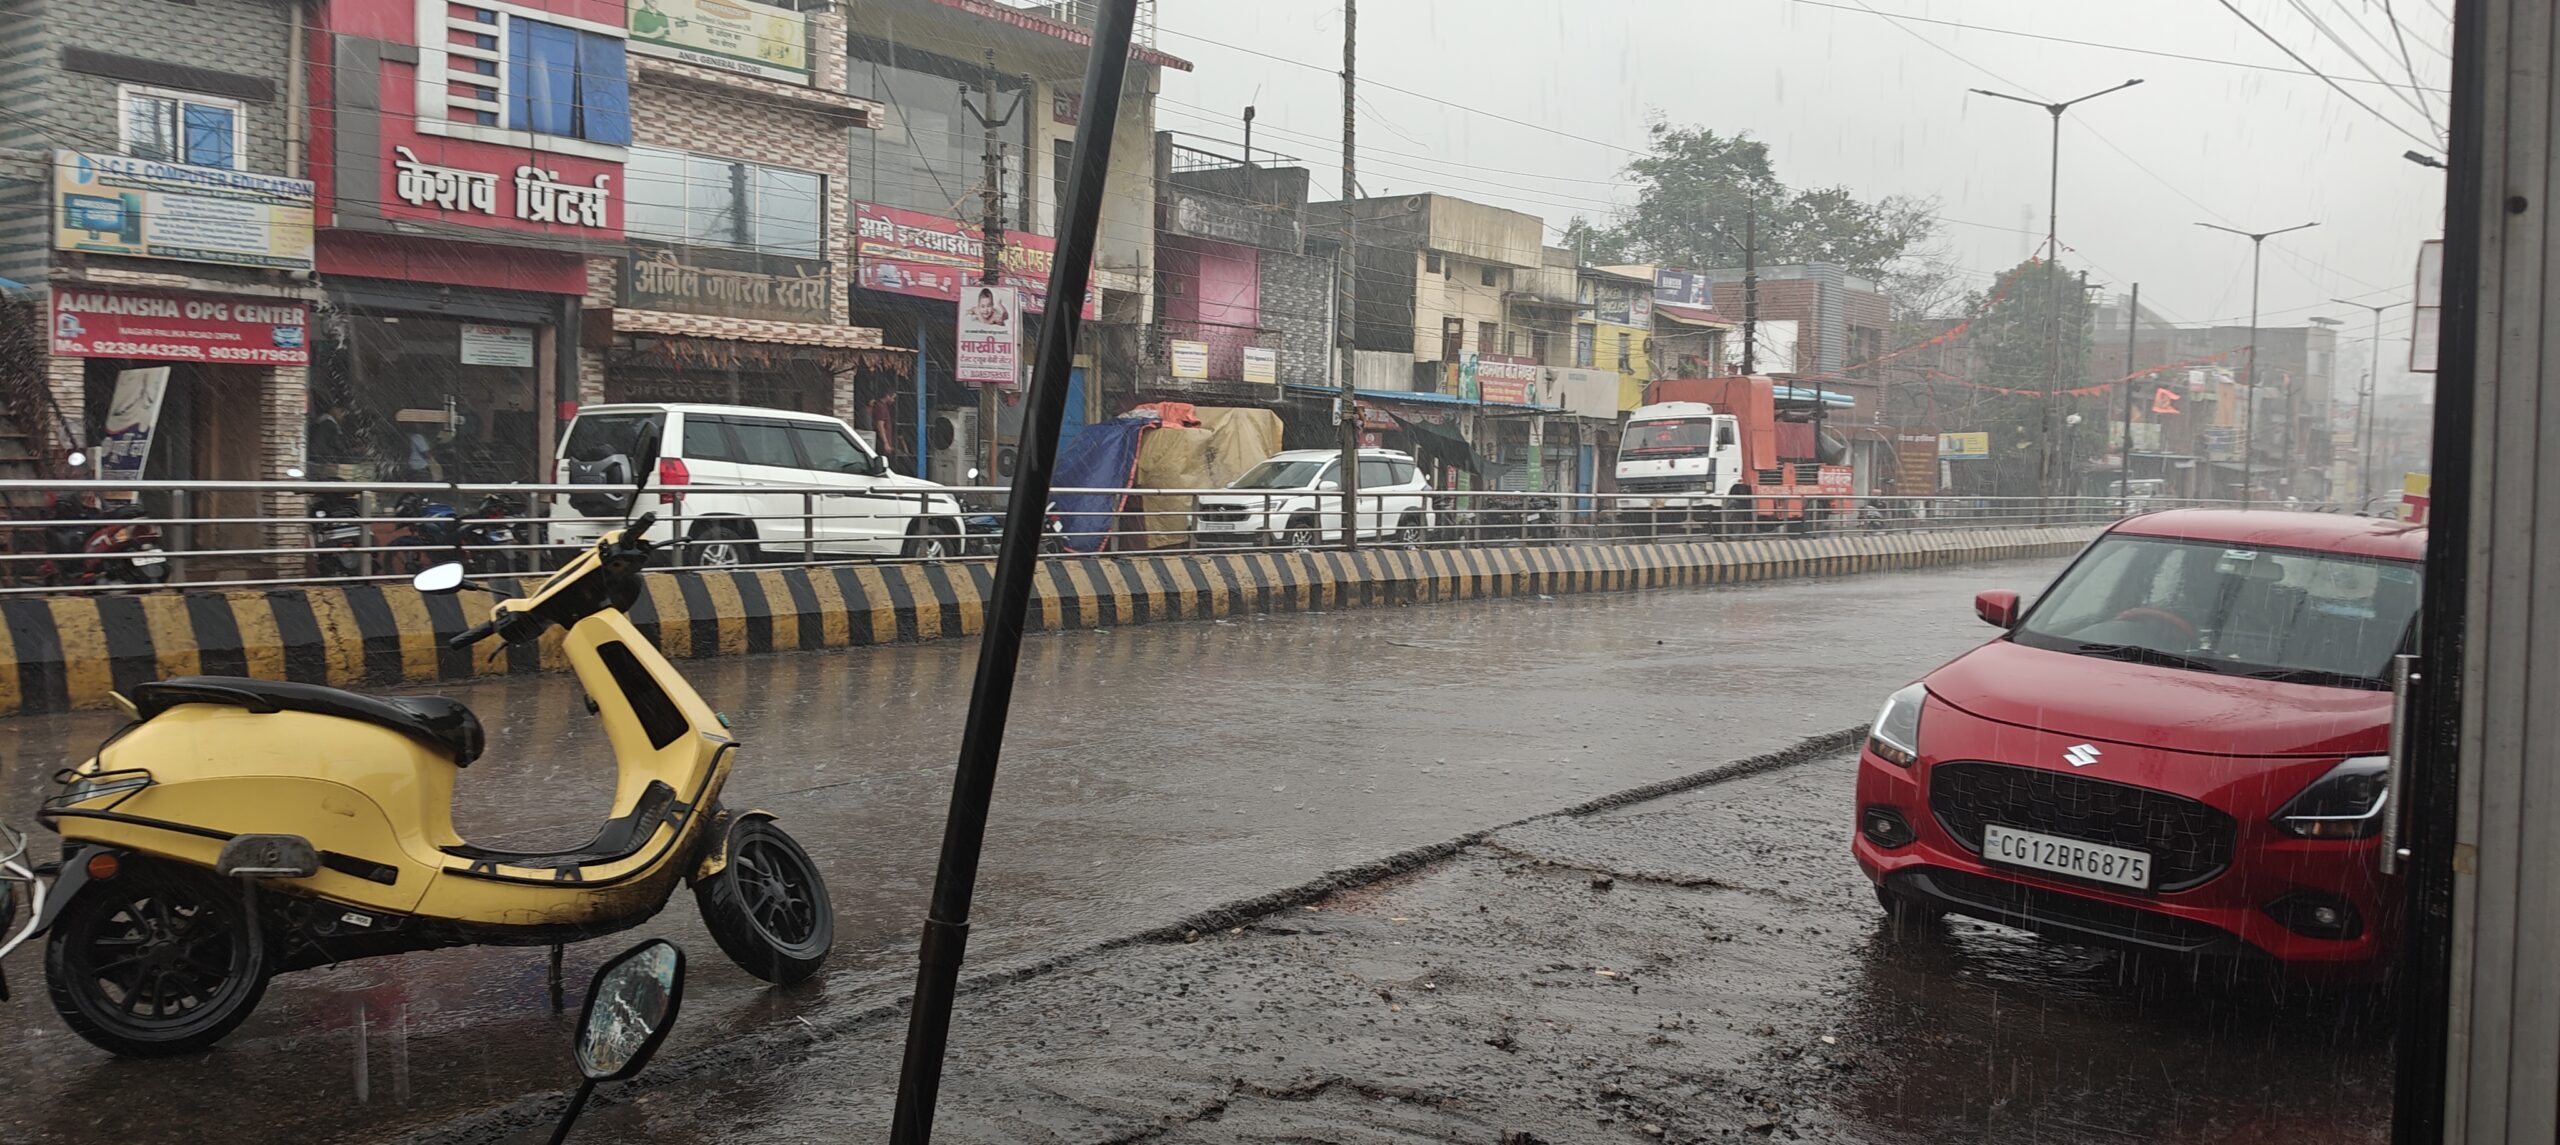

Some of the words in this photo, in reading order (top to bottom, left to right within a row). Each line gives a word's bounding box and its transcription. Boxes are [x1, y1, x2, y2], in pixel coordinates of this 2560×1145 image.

[701, 55, 737, 69] GENERAL
[144, 164, 227, 187] COMPUTER
[234, 174, 313, 197] EDUCATION
[396, 146, 499, 215] केशव
[515, 166, 611, 227] प्रिंटर्स
[57, 293, 179, 319] AAKANSHA
[185, 302, 228, 322] OPG
[234, 305, 305, 325] CENTER
[56, 339, 89, 353] Mo.
[2001, 835, 2144, 882] CG12BR6875
